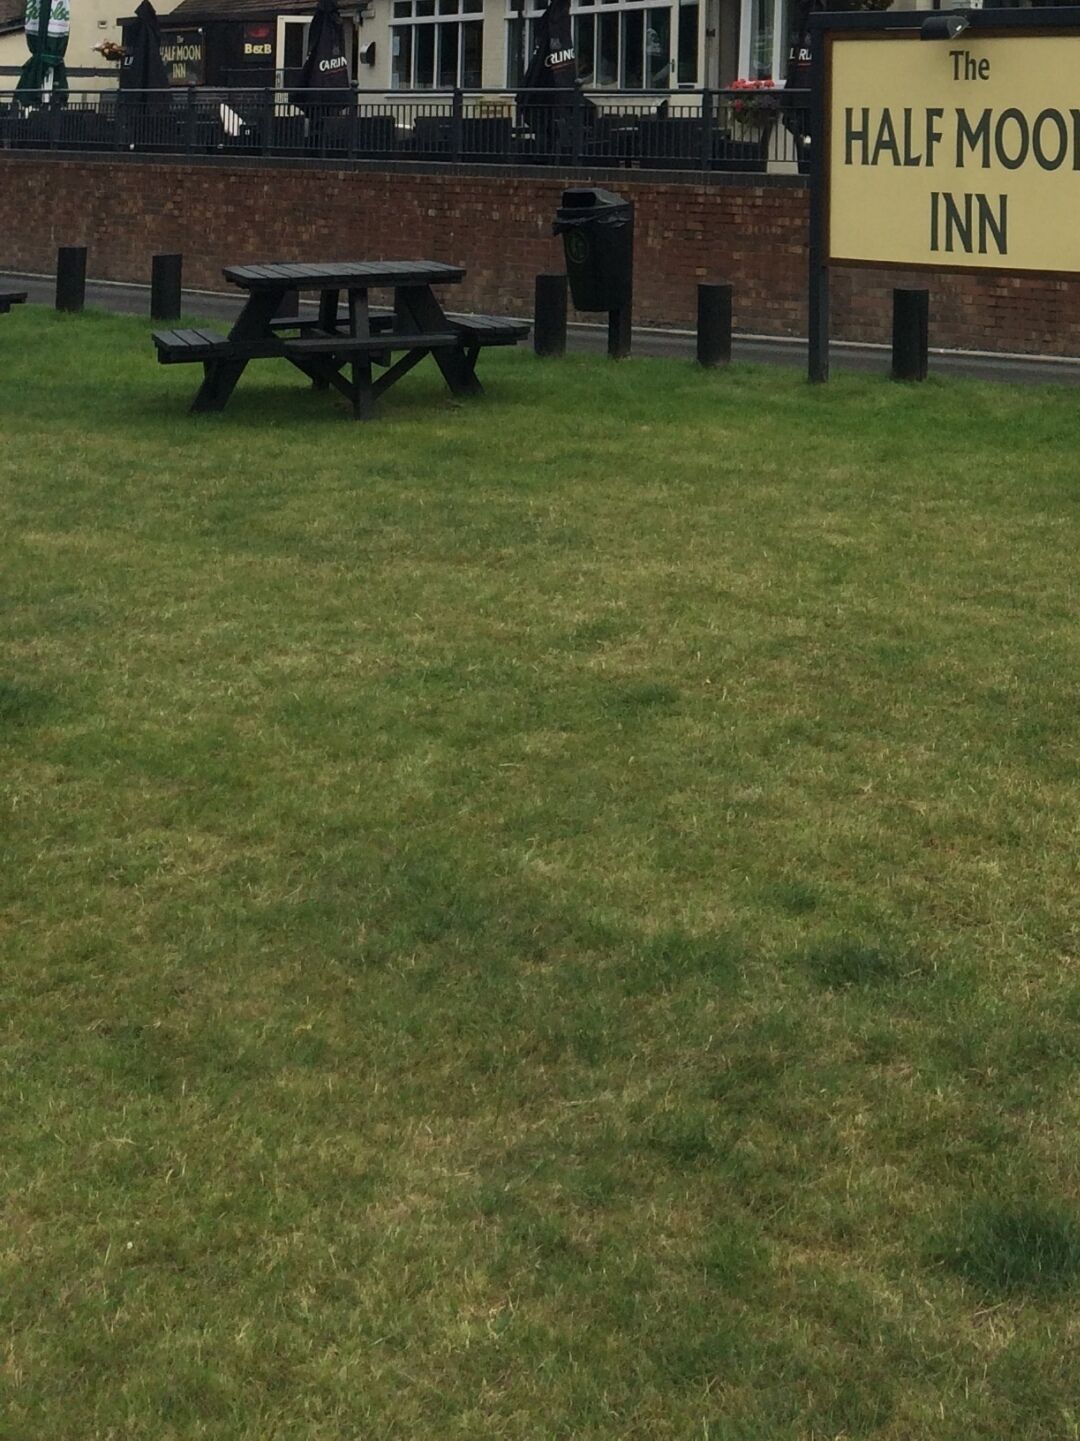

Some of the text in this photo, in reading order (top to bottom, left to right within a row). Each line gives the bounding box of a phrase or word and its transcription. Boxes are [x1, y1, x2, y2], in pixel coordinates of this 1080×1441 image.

[176, 45, 201, 60] MOON
[319, 56, 348, 71] CARLIN
[172, 63, 186, 78] INN
[949, 50, 990, 81] The
[845, 107, 945, 167] HALF
[930, 192, 1008, 255] INN
